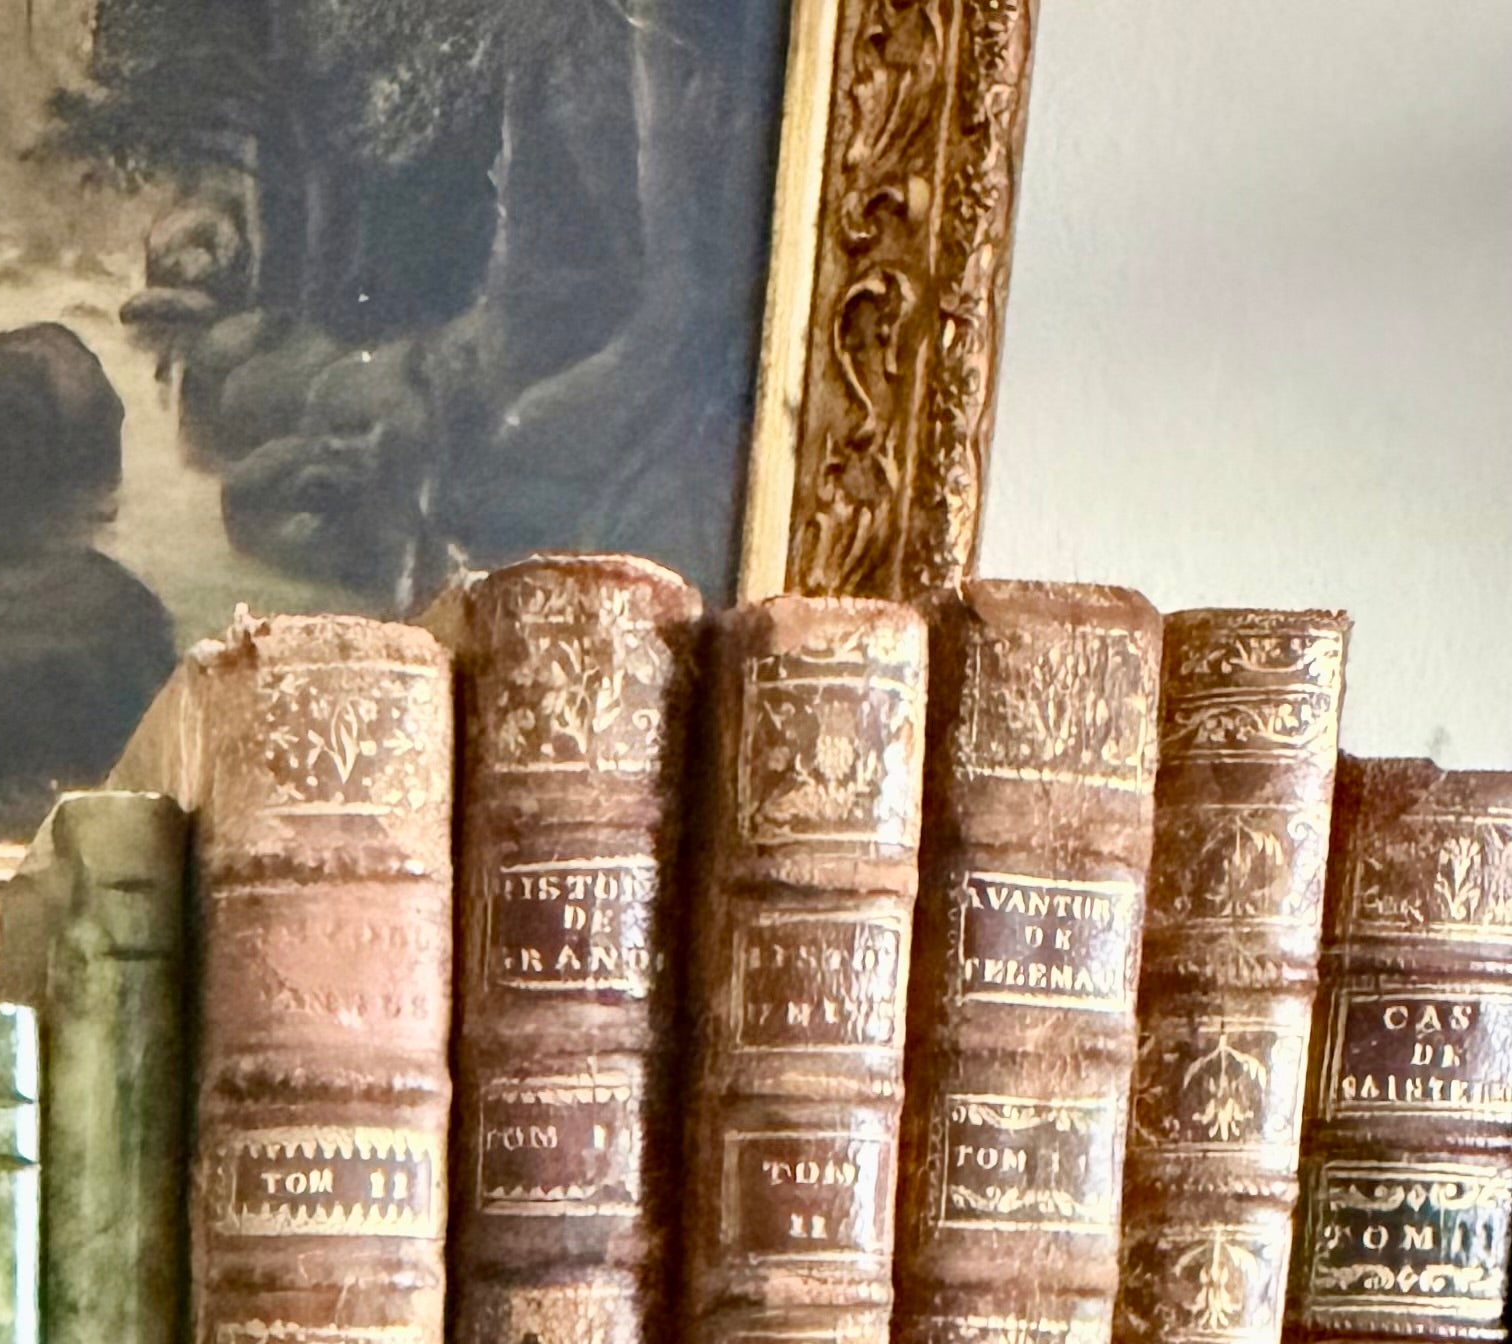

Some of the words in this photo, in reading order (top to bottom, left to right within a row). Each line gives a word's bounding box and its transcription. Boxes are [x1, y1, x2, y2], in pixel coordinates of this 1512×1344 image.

[563, 903, 614, 934] DE
[1383, 1005, 1473, 1034] CAS
[487, 1125, 559, 1151] TOM
[762, 1160, 857, 1186] TOM
[957, 1145, 1028, 1174] TOM
[260, 1167, 334, 1195] TOM
[369, 1168, 409, 1200] II
[789, 1213, 829, 1239] II
[1323, 1223, 1435, 1252] TOM
